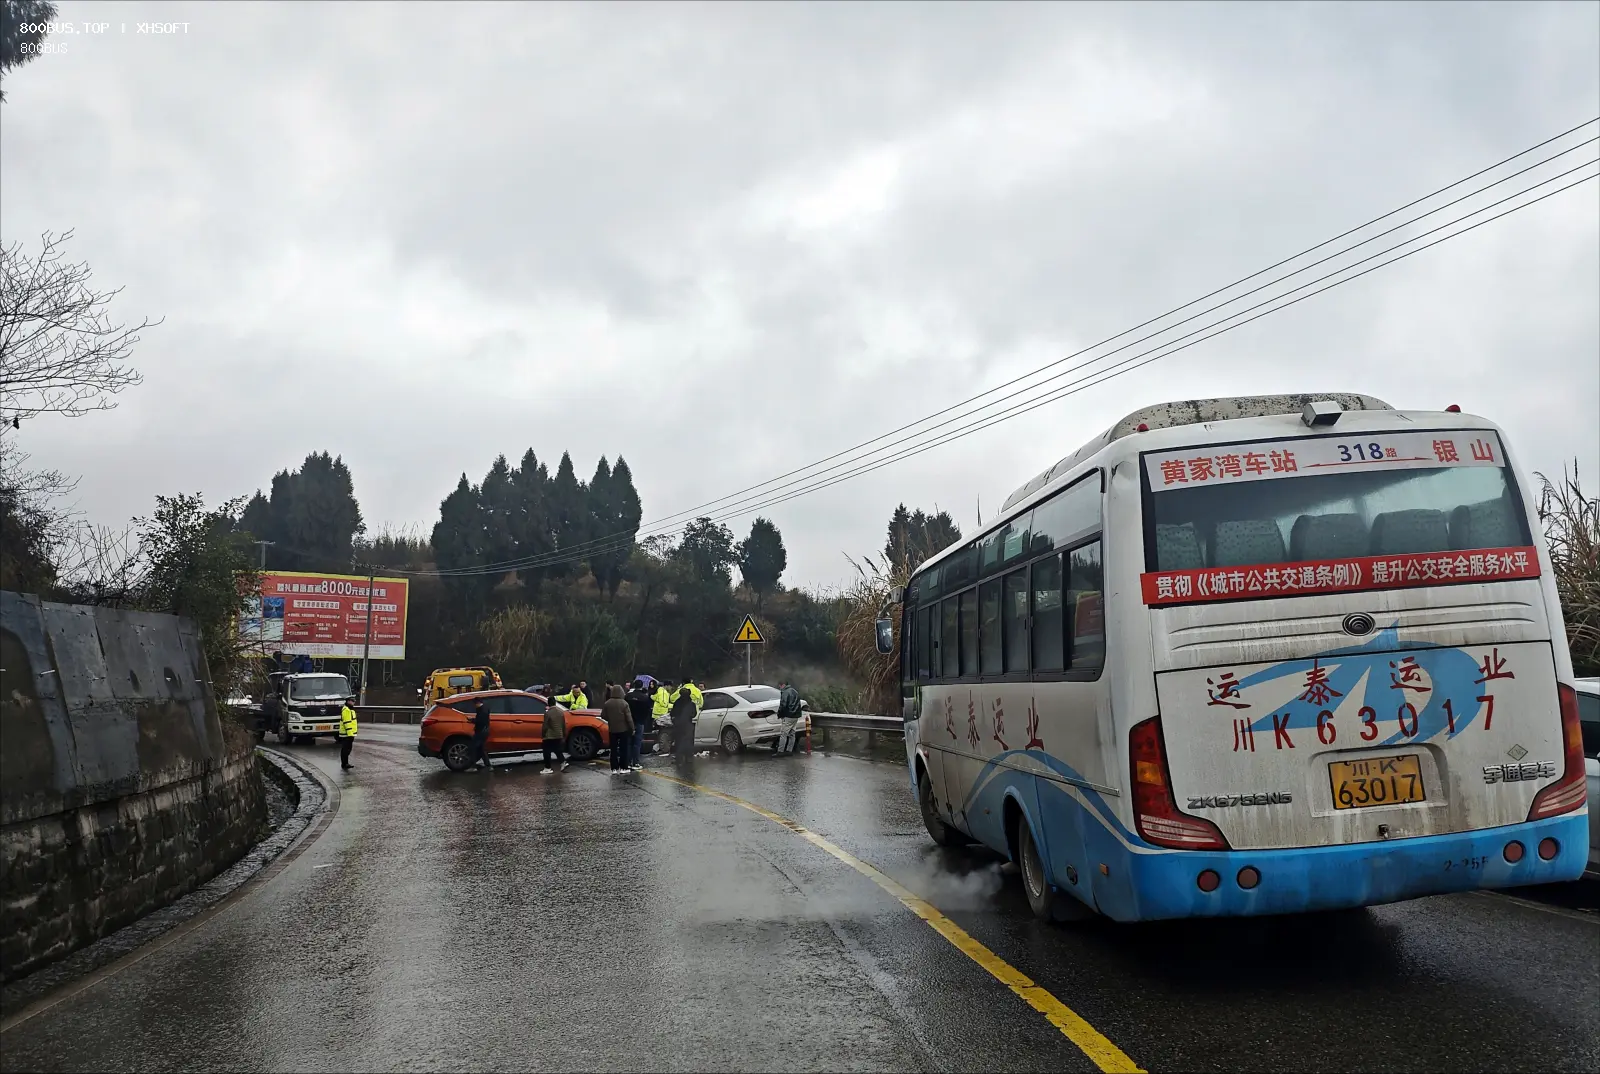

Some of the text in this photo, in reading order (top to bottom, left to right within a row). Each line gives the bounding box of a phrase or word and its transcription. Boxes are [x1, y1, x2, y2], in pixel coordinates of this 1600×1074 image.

[1160, 448, 1298, 486] 黄家湾车站
[1432, 438, 1495, 465] 银山
[1155, 550, 1530, 600] 贯彻《城市公共交通条例》 提升公交安全服务水平
[1232, 694, 1495, 753] 川K63017
[1338, 773, 1417, 805] 63017
[1482, 760, 1557, 784] 宇通客车
